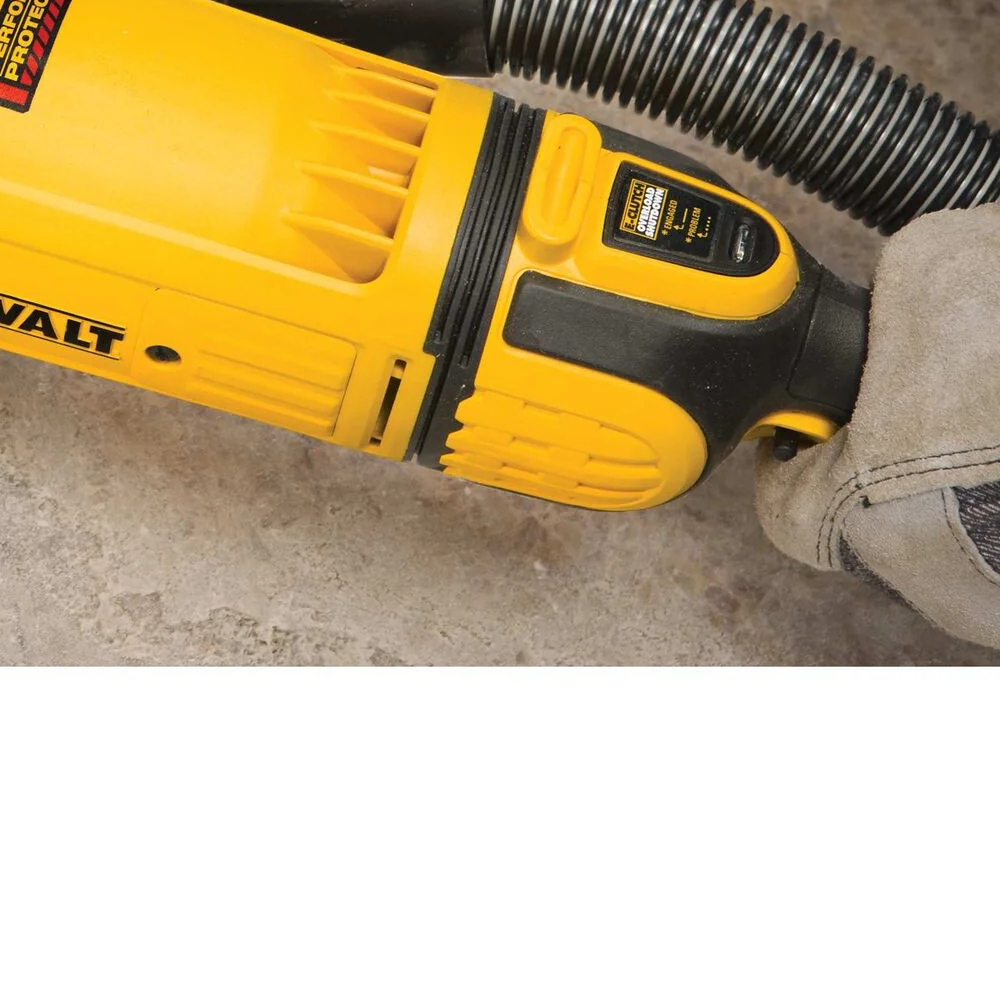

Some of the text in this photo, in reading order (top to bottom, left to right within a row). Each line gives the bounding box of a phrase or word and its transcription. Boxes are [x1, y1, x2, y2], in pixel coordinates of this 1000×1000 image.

[625, 182, 646, 230] E-CLUTCH
[636, 186, 655, 233] OVERLOAD
[645, 187, 666, 238] SHUTDOWN
[663, 199, 678, 230] ENGAGED
[689, 206, 702, 238] PROBLEM
